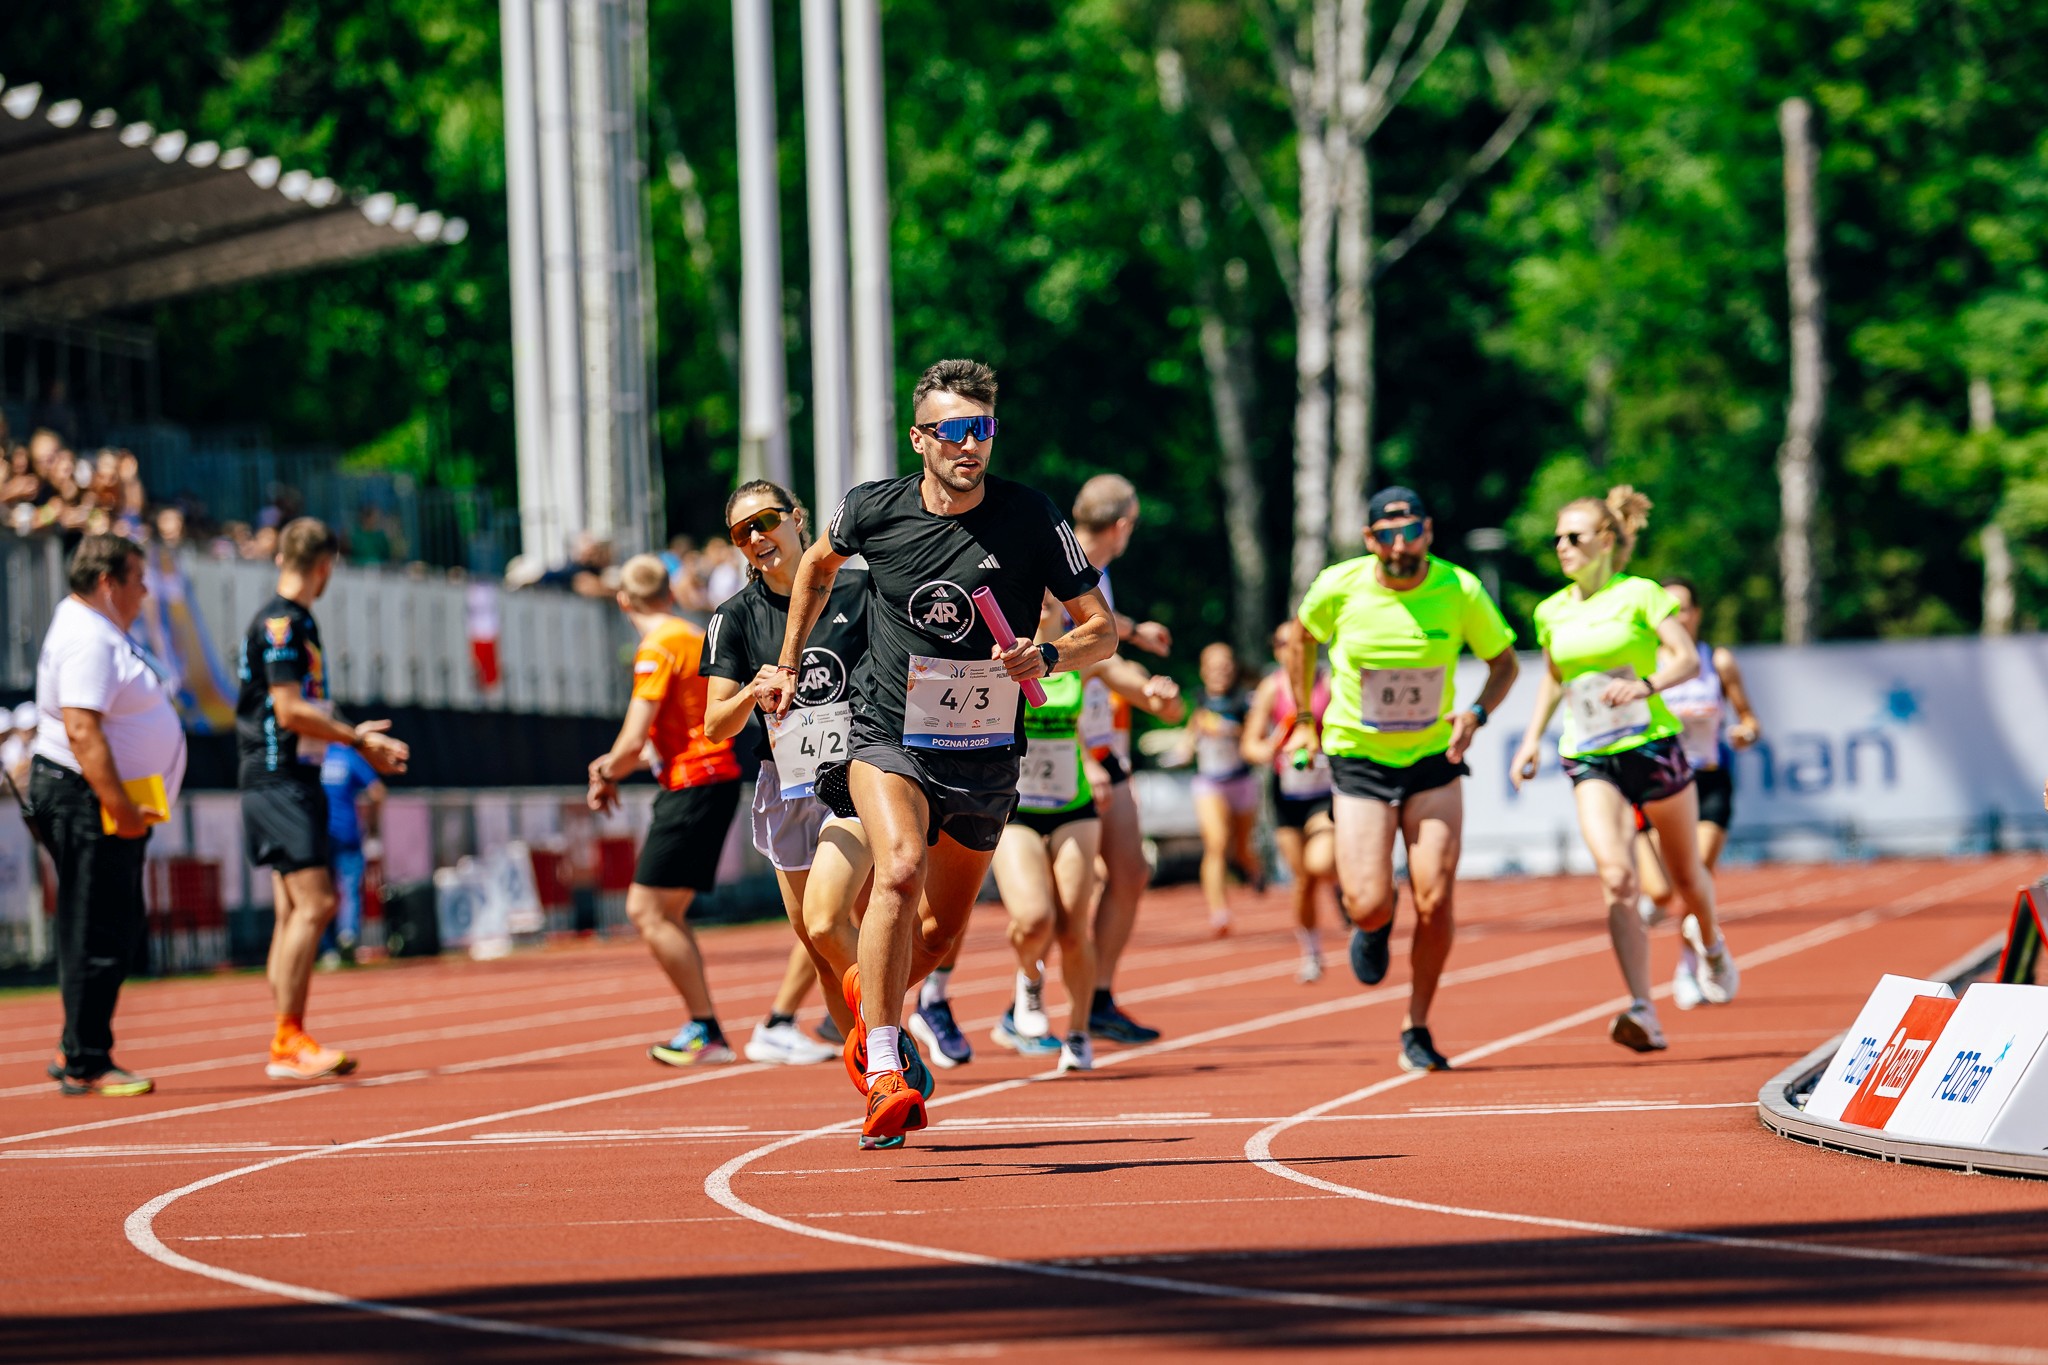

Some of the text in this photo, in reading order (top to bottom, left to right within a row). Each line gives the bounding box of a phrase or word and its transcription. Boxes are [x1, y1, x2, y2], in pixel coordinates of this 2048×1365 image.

[923, 602, 960, 624] AR
[798, 666, 834, 692] AR
[940, 685, 990, 714] 4/3
[1382, 686, 1421, 707] 8/3
[800, 730, 843, 759] 4/2
[932, 738, 990, 748] POZNAŃ 2025
[1881, 1048, 1924, 1089] ORLEN
